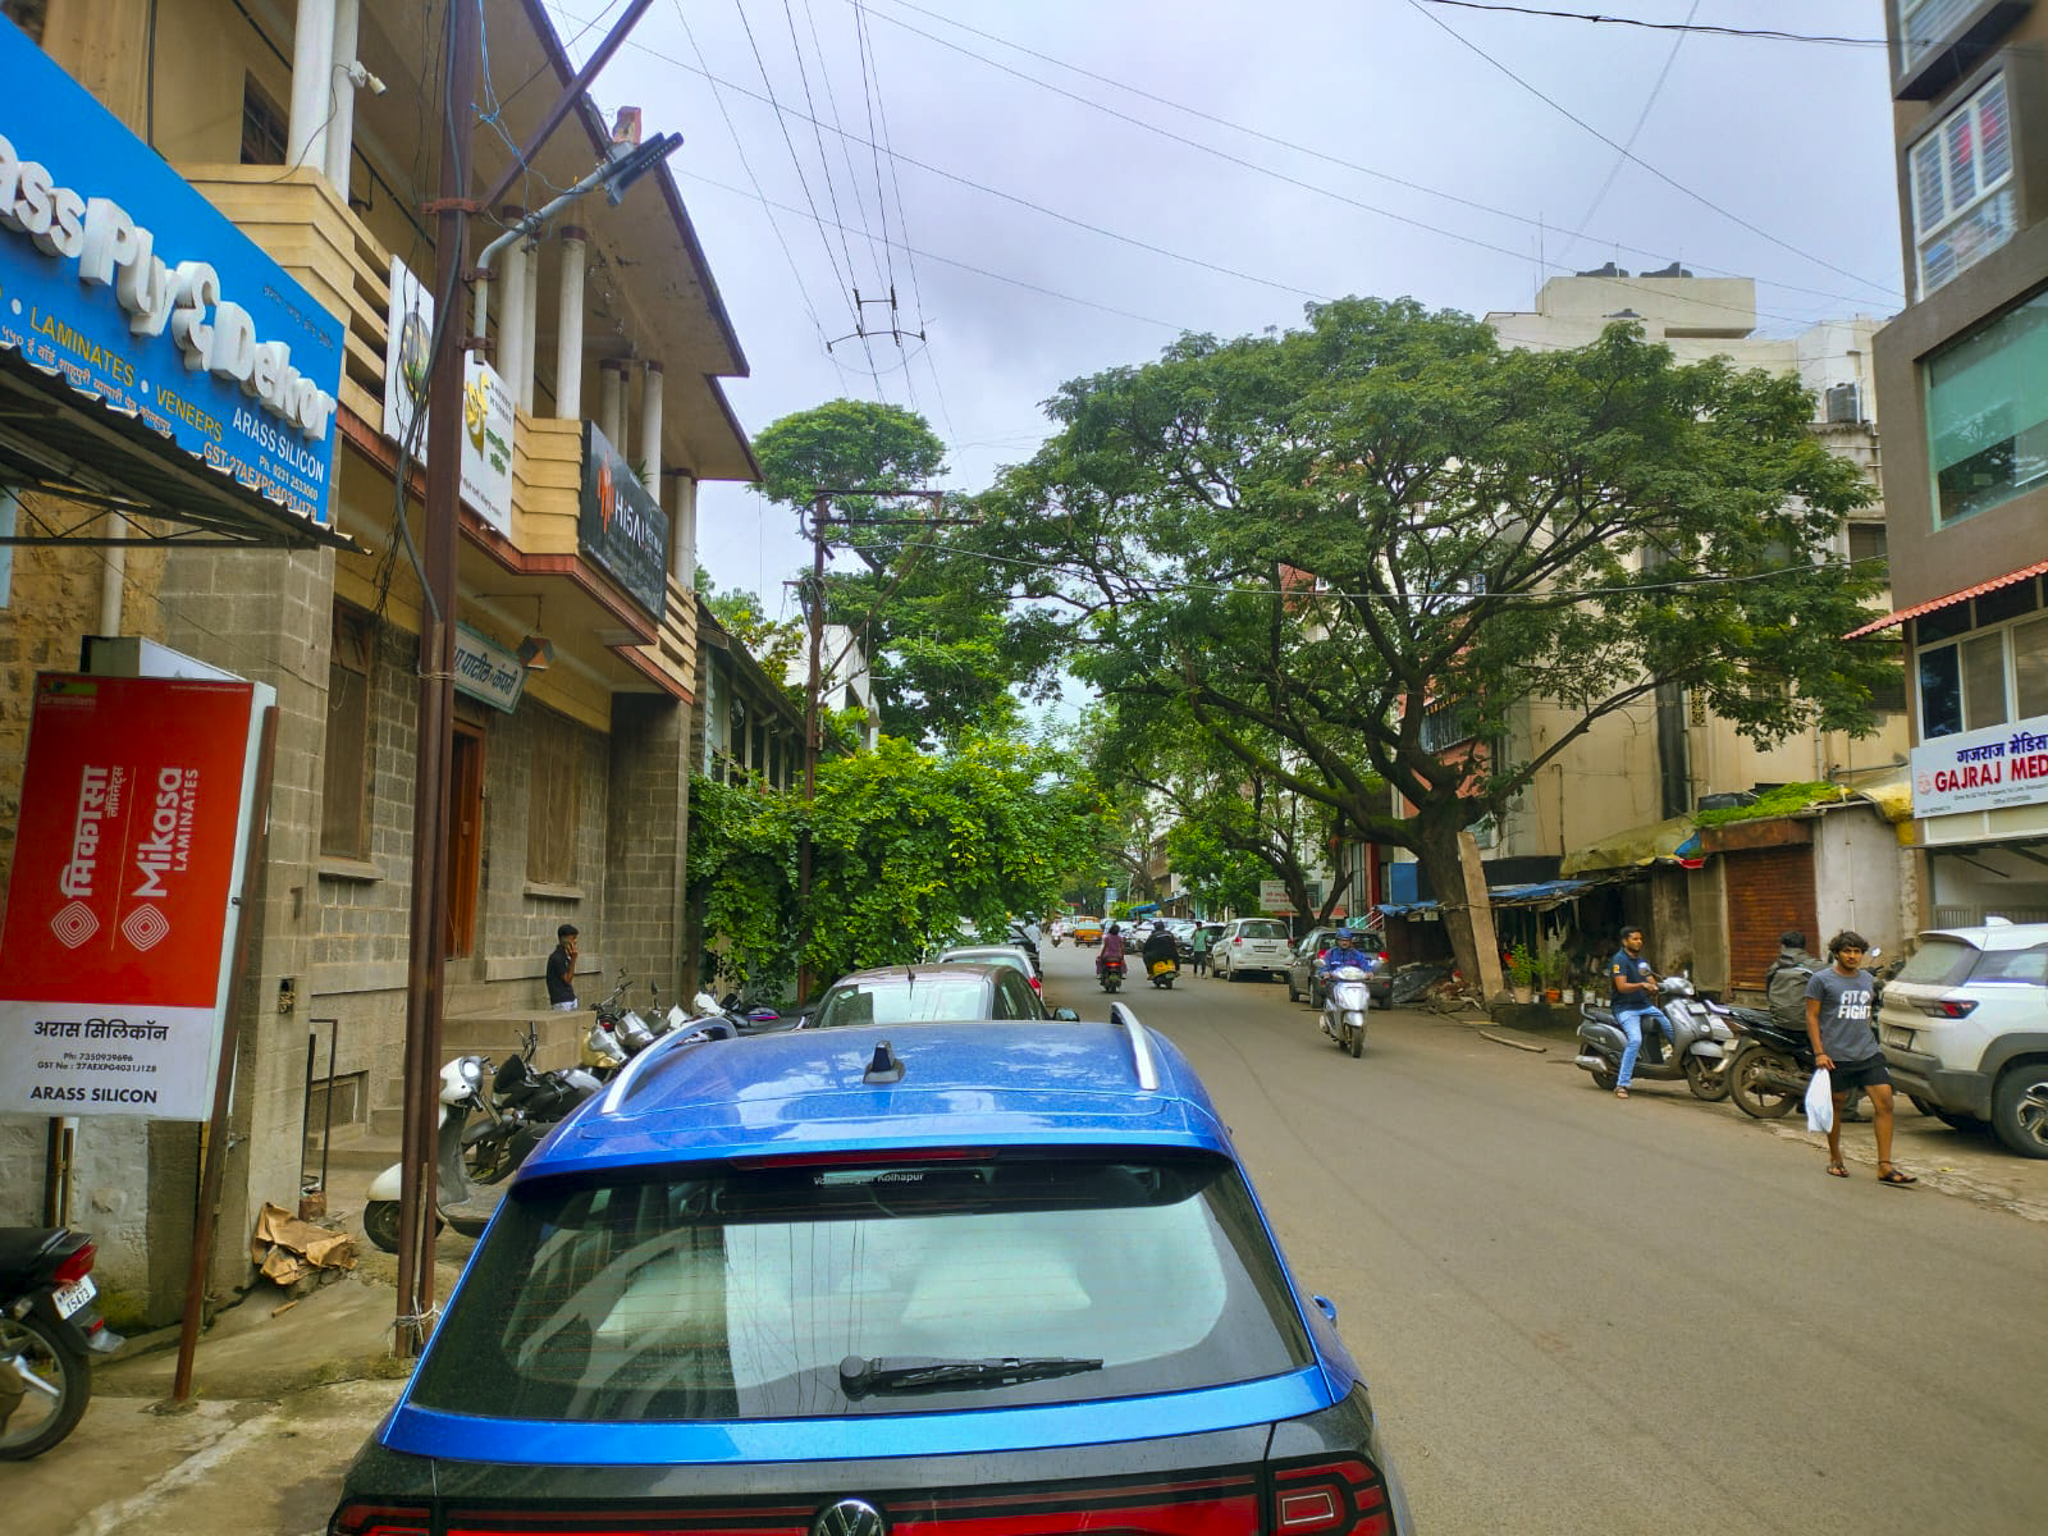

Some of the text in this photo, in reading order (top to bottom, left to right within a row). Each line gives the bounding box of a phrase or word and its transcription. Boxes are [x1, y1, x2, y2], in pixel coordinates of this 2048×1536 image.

[30, 306, 225, 444] LAMINATES VENEERS
[232, 406, 325, 484] ARASS SILICON
[1934, 761, 2003, 792] GAJRAJ
[2011, 754, 2048, 781] MED
[1956, 742, 2007, 763] गजराज
[60, 765, 108, 899] मिकासा
[131, 767, 183, 897] Mikasa
[174, 769, 199, 872] LAMINATES
[34, 1018, 170, 1041] अरास सिलिकॉन
[37, 1061, 54, 1070] GST
[30, 1086, 158, 1104] ARASS SILICON
